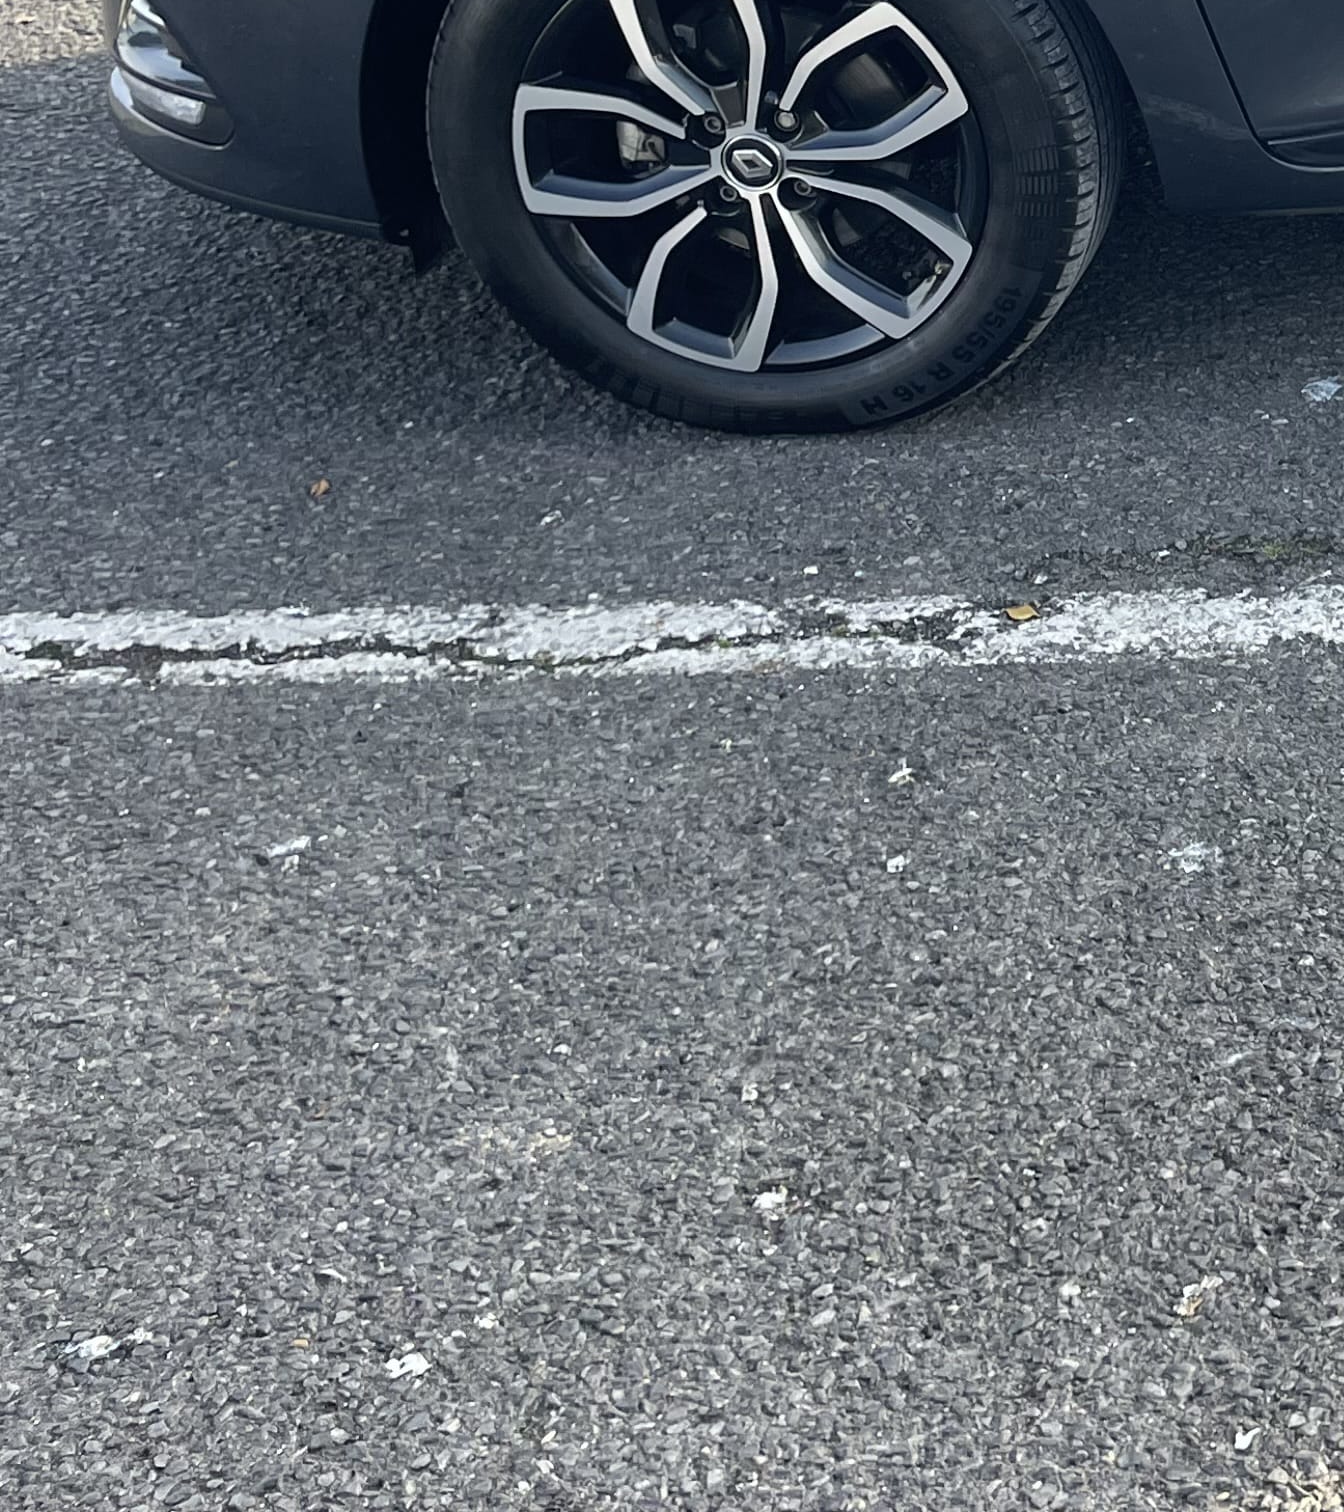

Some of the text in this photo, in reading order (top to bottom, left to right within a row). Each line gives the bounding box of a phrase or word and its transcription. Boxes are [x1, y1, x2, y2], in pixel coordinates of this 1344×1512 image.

[860, 288, 1022, 416] 195/55 R 16 H
